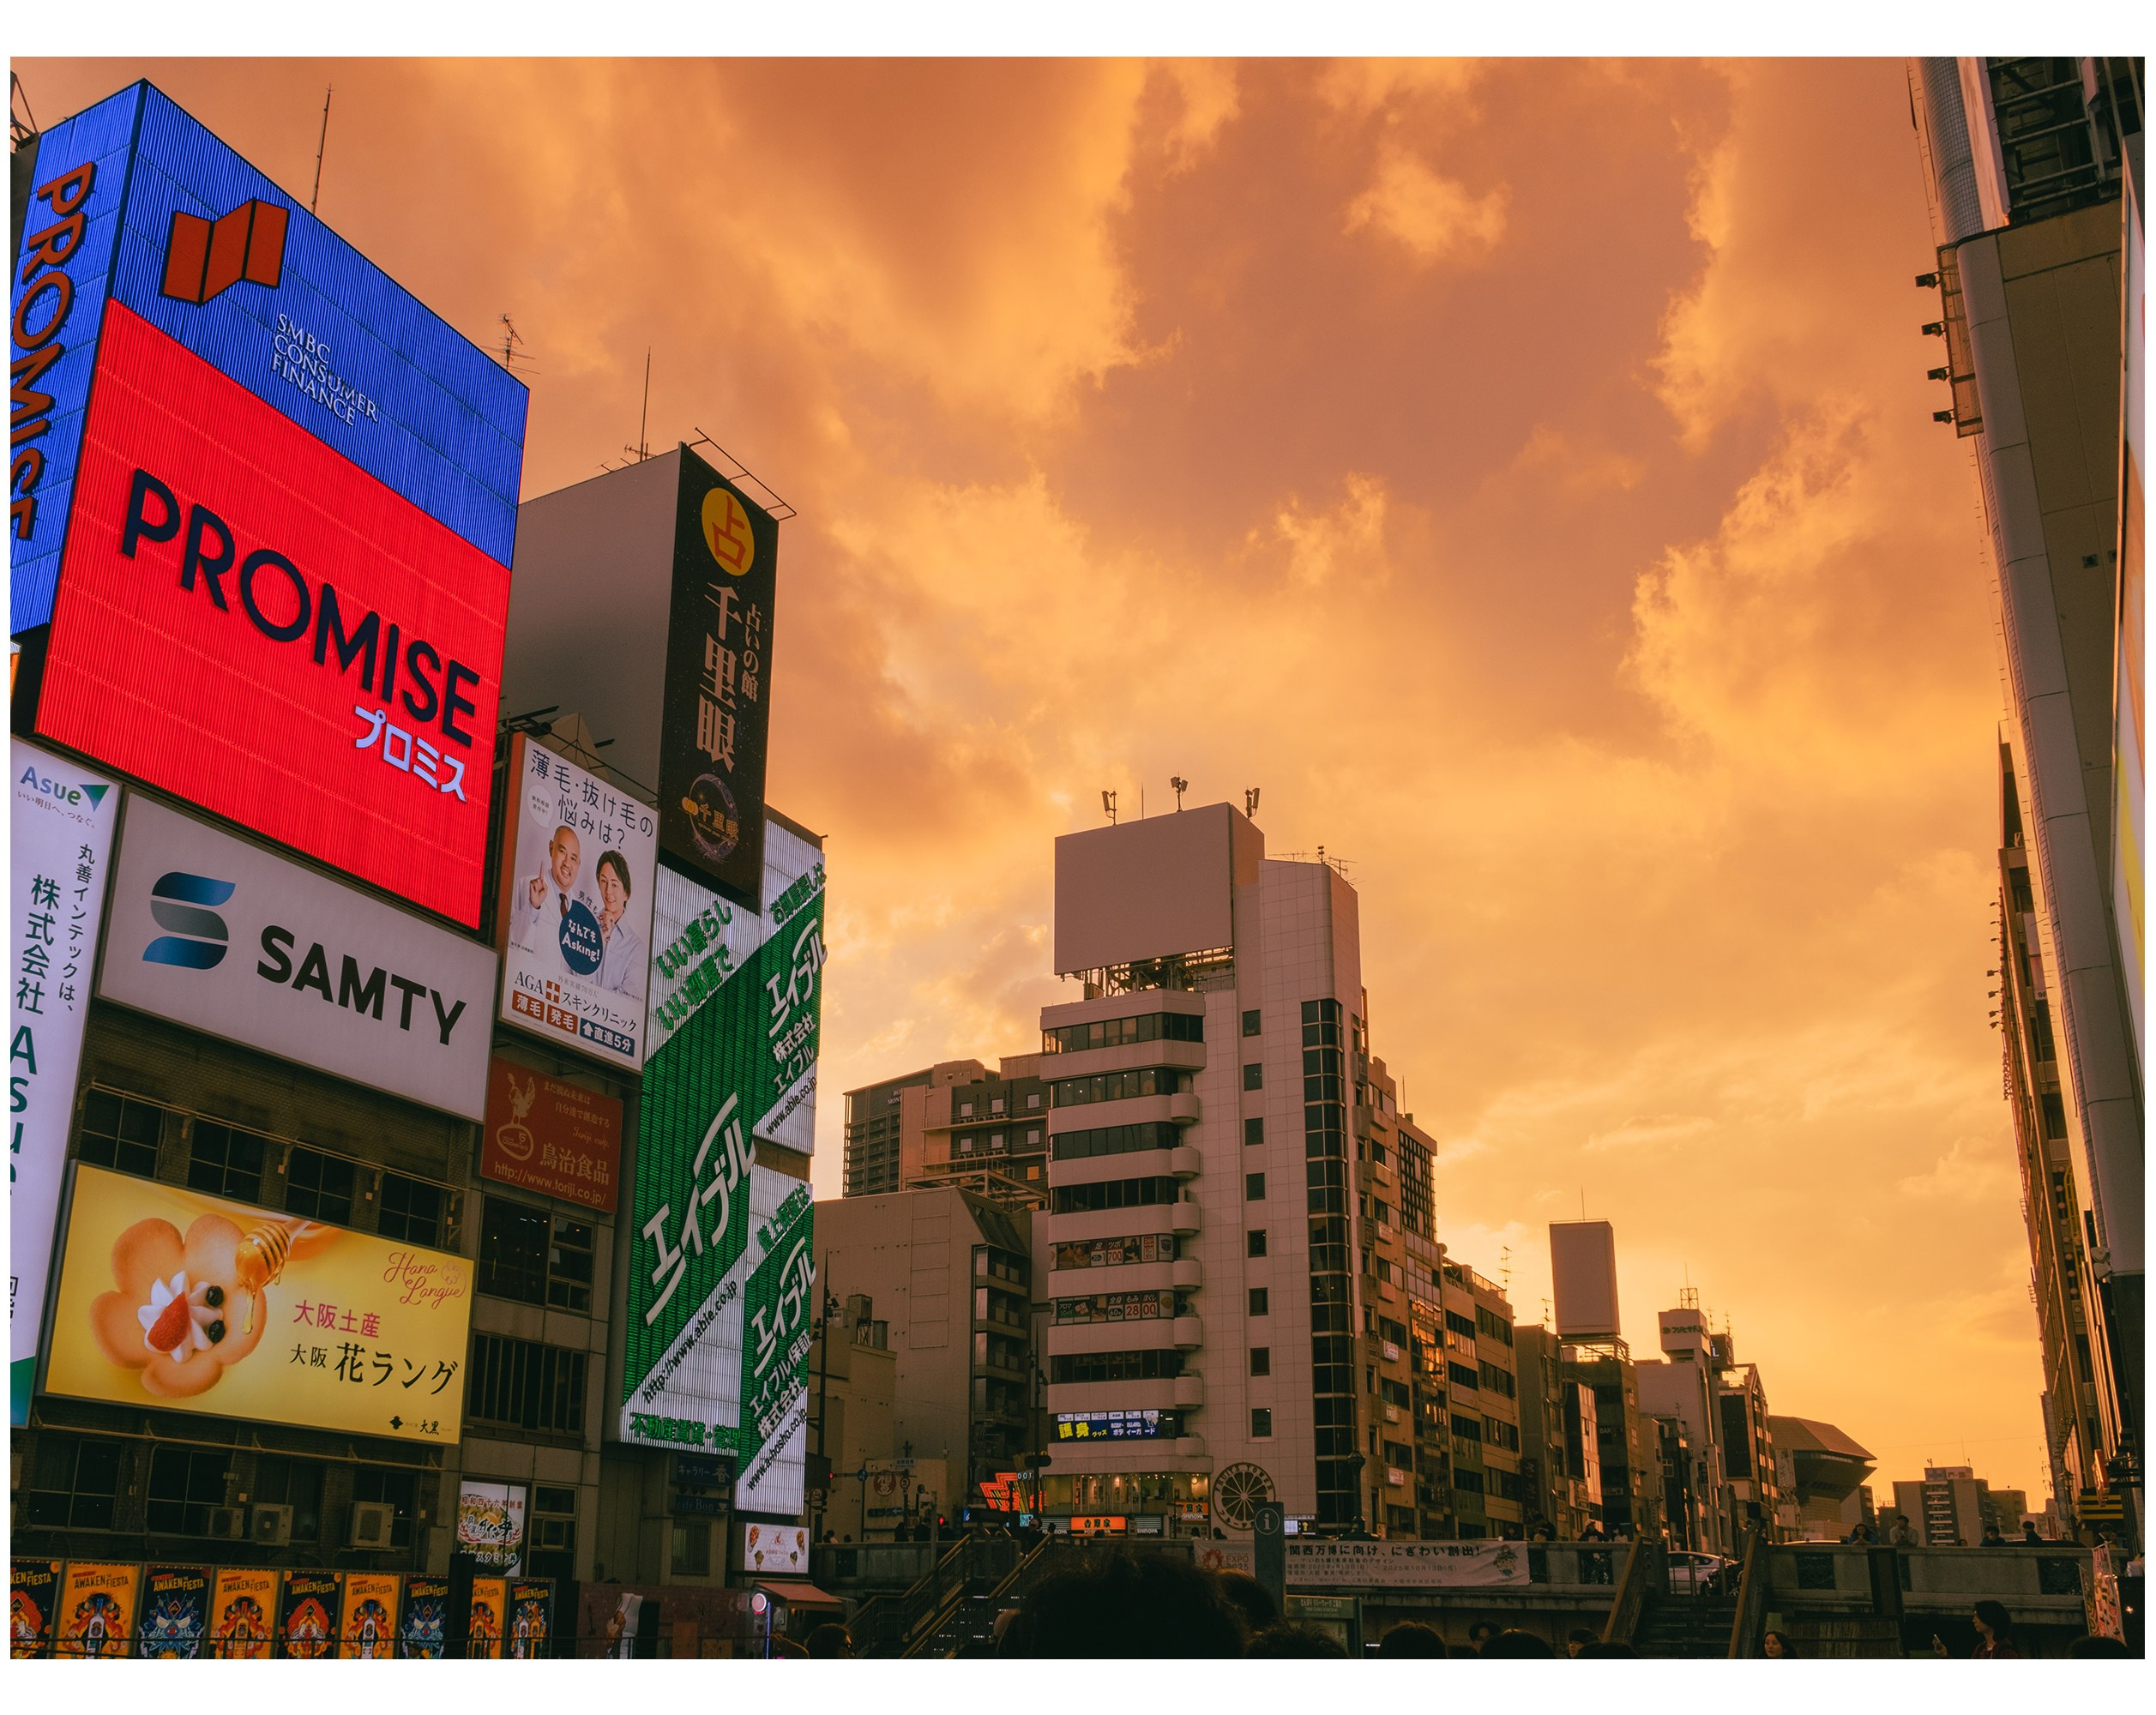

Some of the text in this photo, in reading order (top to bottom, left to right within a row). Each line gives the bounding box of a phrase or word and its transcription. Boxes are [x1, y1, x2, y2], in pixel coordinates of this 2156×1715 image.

[278, 314, 330, 364] SMBC
[271, 353, 356, 427] FINANCE
[274, 338, 378, 424] CONSUMER
[712, 495, 746, 570] 占
[122, 468, 480, 748] PROMISE
[696, 582, 743, 773] 千里眼
[740, 603, 762, 702] 占いの館
[354, 703, 467, 803] プロミス
[20, 767, 81, 807] Asue
[530, 749, 653, 838] 薄毛・抜け毛の
[558, 794, 625, 850] 悩みは?
[699, 803, 739, 841] 千里眼
[16, 873, 61, 1015] 株式会社
[59, 843, 95, 1012] 丸善インテックは、
[561, 931, 601, 963] Asking!
[568, 918, 597, 944] なんでも
[656, 900, 732, 979] いい暮らし
[257, 924, 467, 1046] SAMTY
[515, 971, 637, 1033] AGA スキンクリニック
[657, 943, 734, 1030] いい部屋で
[766, 921, 828, 1034] エイブル
[516, 995, 542, 1019] 薄毛
[551, 1008, 575, 1032] 発毛
[593, 1026, 632, 1054] 直進5分
[773, 1011, 817, 1063] 株式会社
[774, 1044, 815, 1095] エイブル
[766, 1076, 818, 1136] www.able.co.jp
[494, 1161, 607, 1206] http://www.toriji.co.jp/
[539, 1142, 610, 1186] 鳥治食品
[642, 1098, 757, 1317] エイブル
[382, 1251, 439, 1285] Hana
[292, 1298, 382, 1339] 大阪土産
[398, 1276, 467, 1311] Langue
[751, 1240, 817, 1374] エイブル
[641, 1280, 738, 1404] http://www.able.co.jp
[289, 1341, 458, 1397] 大阪 花ラング
[749, 1329, 813, 1419] エイブル保証
[757, 1376, 807, 1441] 株式会社
[746, 1407, 808, 1491] www.a-hosho.co.jp
[1214, 1465, 1274, 1492] FRUITS TOWER
[27, 1572, 51, 1586] FIESTA
[75, 1572, 105, 1590] AWAKEN
[106, 1576, 129, 1589] FIESTA
[154, 1575, 184, 1592] AWAKEN
[183, 1577, 204, 1592] FIESTA
[223, 1578, 250, 1593] AWAKEN
[250, 1580, 270, 1592] FIESTA
[292, 1580, 317, 1595] AWAKEN
[316, 1582, 335, 1594] FIESTA
[352, 1582, 375, 1596] AWAKEN
[375, 1584, 392, 1596] FIESTA
[411, 1585, 433, 1598] AWAKEN
[515, 1588, 534, 1601] AWAKEN
